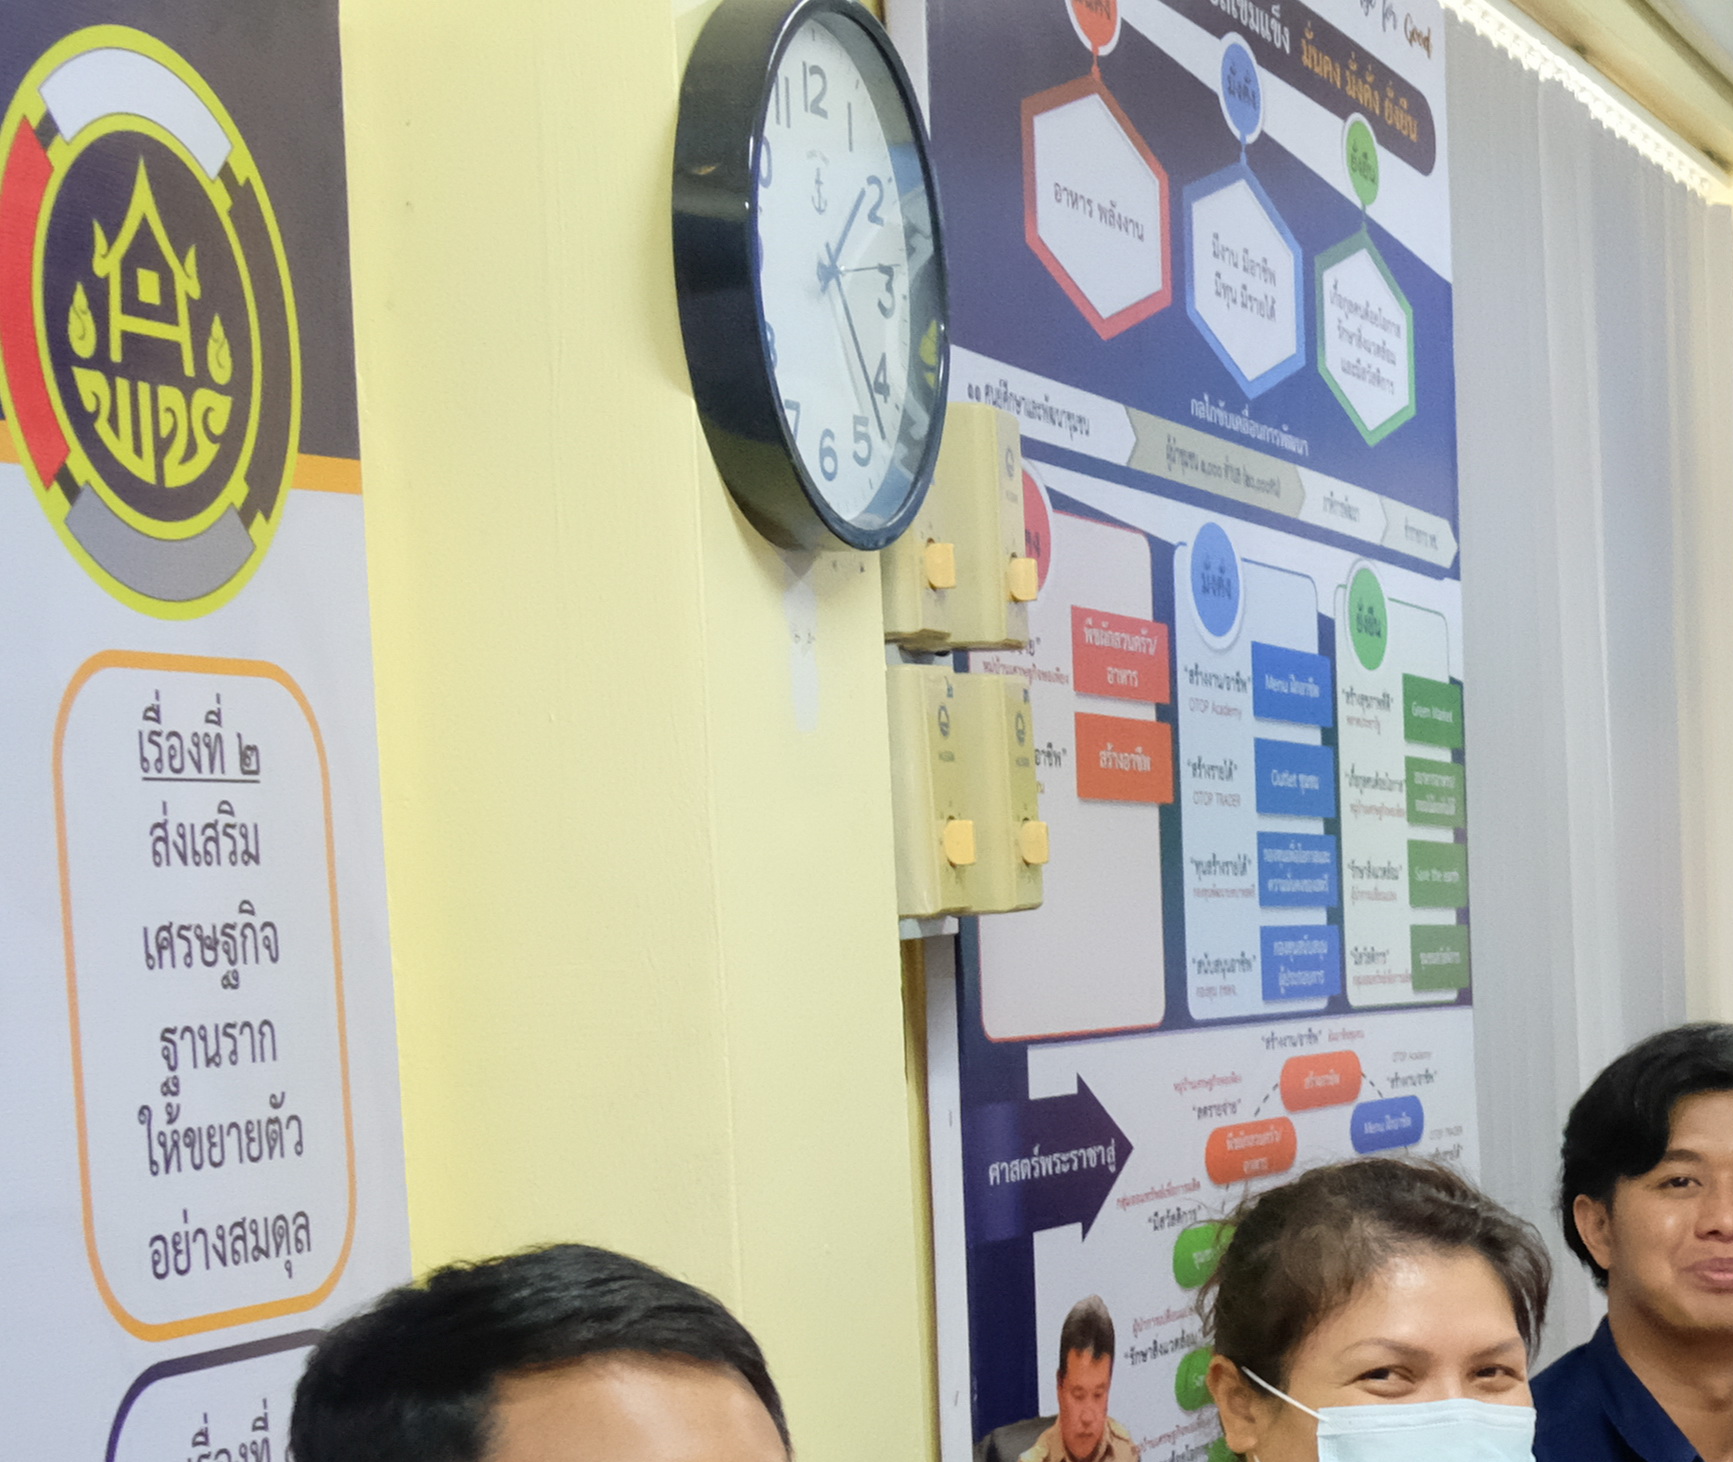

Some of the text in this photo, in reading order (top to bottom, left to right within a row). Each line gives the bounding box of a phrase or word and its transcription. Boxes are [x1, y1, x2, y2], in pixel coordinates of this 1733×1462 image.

[802, 61, 828, 120] 12
[1301, 20, 1341, 89] มั่นคง
[1345, 50, 1380, 116] มั่งคั่ง
[1384, 80, 1418, 143] ยั่งยืน
[865, 175, 885, 226] 2
[1053, 182, 1145, 243] อาหาร พลังงาน
[876, 263, 896, 319] 3
[873, 352, 891, 403] 4
[818, 428, 838, 482] 6
[852, 415, 874, 467] 5
[1106, 666, 1139, 688] อาหาร
[137, 690, 261, 776] เรื่องที่ ๒
[149, 800, 261, 868] ส่งเสริม
[142, 900, 280, 990] เศรษฐกิจ
[159, 1017, 277, 1095] ฐานราก
[137, 1092, 305, 1177] ให้ขยายตัว
[150, 1207, 312, 1282] อย่างสมดุล
